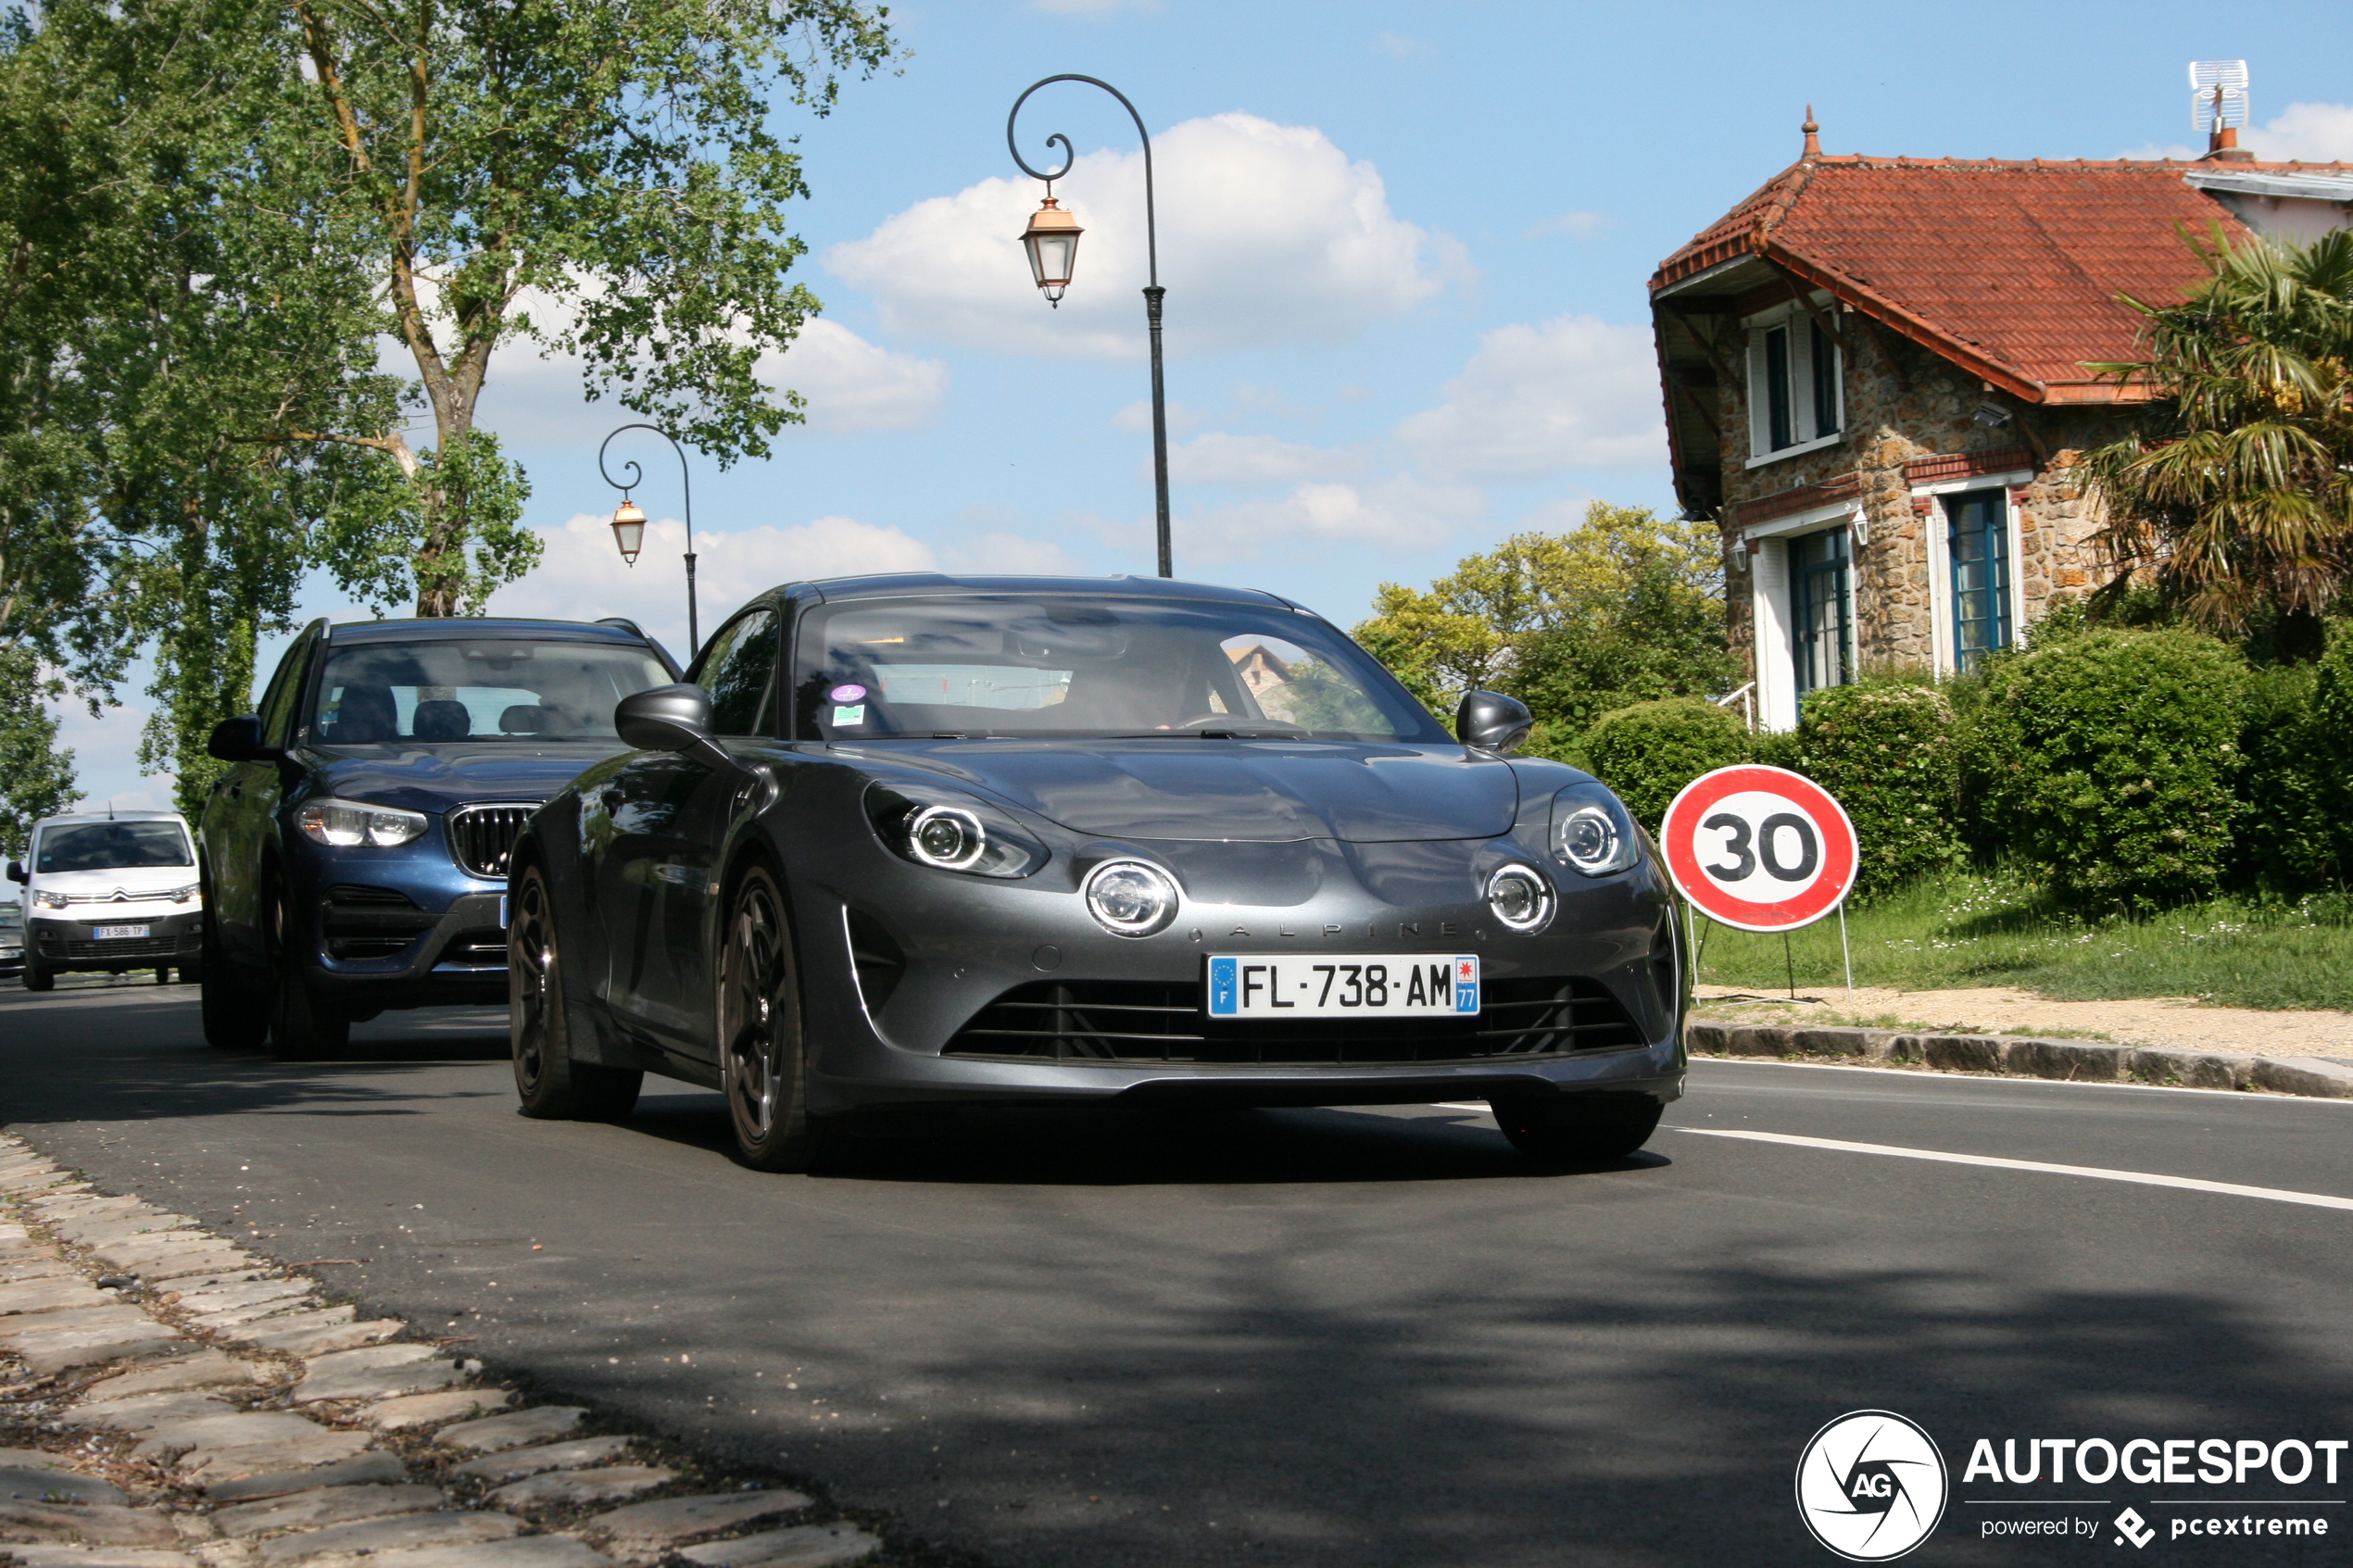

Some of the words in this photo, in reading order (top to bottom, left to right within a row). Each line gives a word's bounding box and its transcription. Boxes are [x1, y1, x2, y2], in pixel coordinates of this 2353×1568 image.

[1703, 812, 1818, 882] 30
[1229, 922, 1457, 937] ALPINE
[1242, 964, 1452, 1008] FL-738-AM
[1219, 991, 1228, 1004] F
[1458, 989, 1475, 1008] 77
